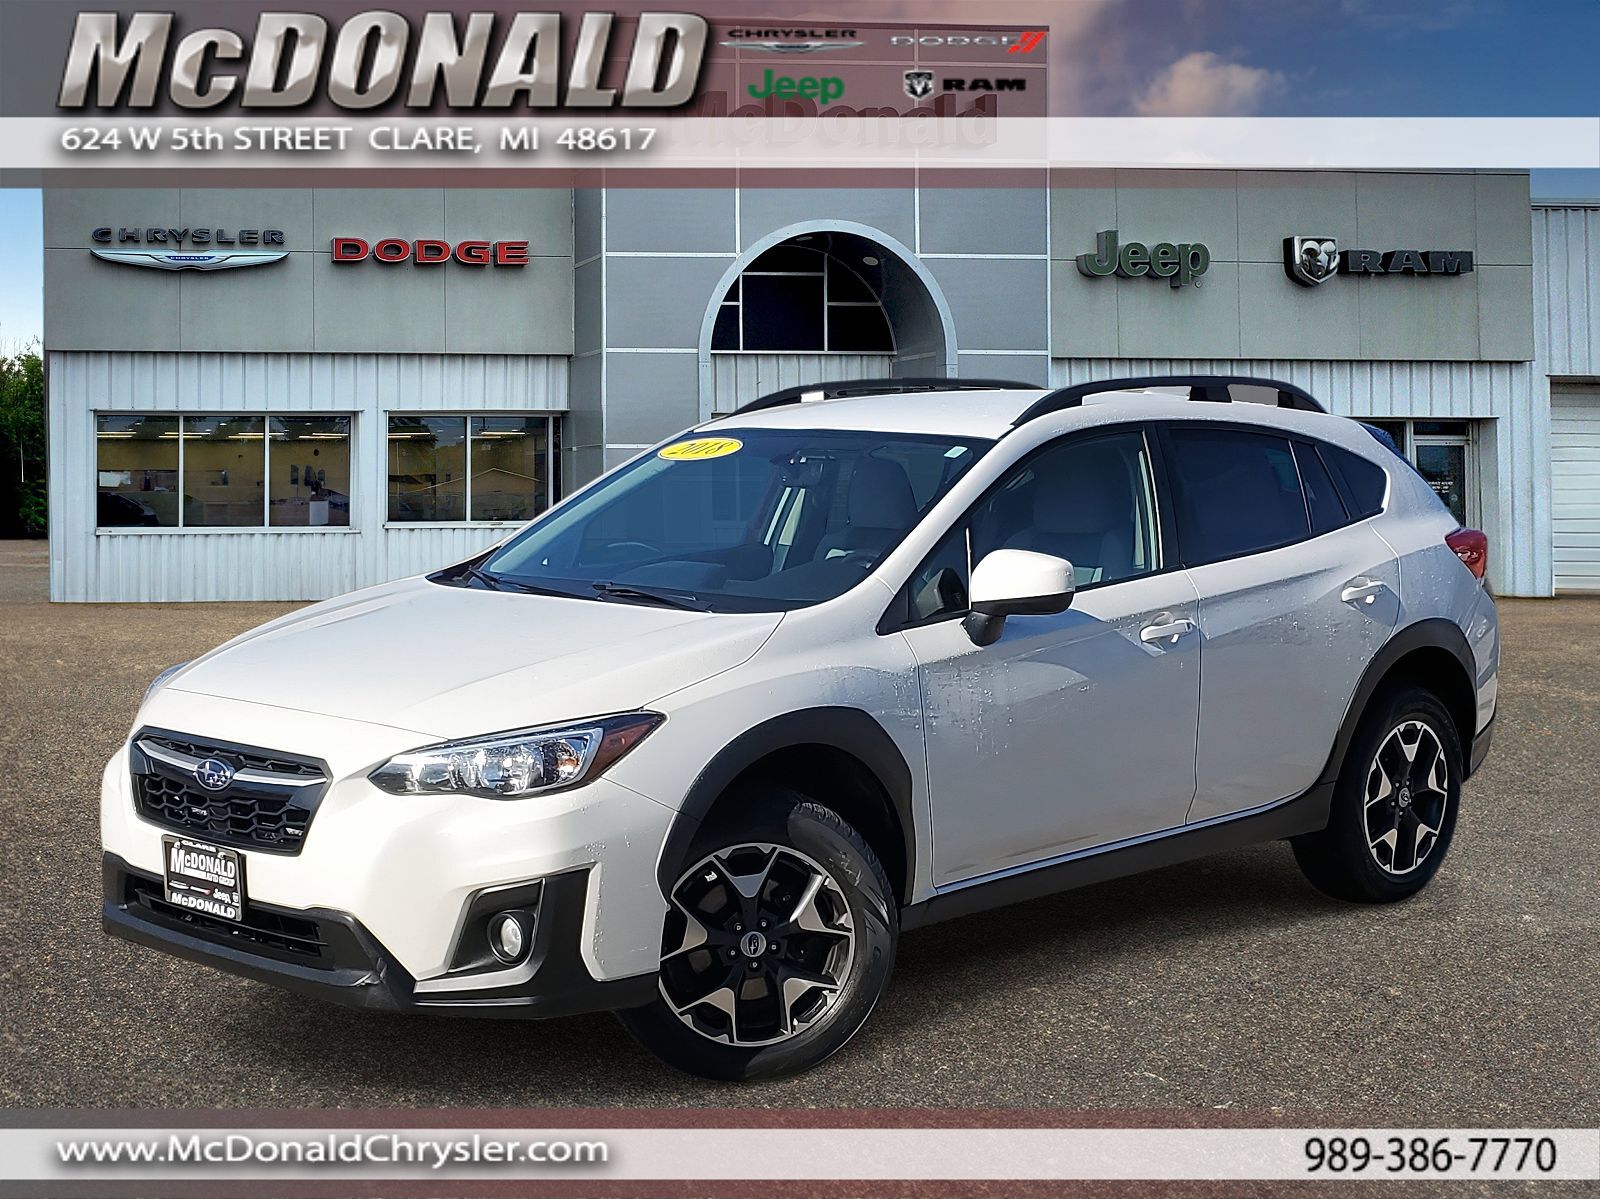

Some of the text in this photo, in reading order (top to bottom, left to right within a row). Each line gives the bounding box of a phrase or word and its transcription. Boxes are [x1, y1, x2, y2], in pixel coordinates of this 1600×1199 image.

[92, 227, 285, 244] CHRYSLER
[331, 237, 530, 269] DODGE
[1077, 230, 1211, 288] Jeep
[1342, 249, 1474, 275] RAM
[668, 442, 734, 455] 2018
[170, 847, 236, 878] McDONALD
[171, 892, 236, 919] McDONALD
